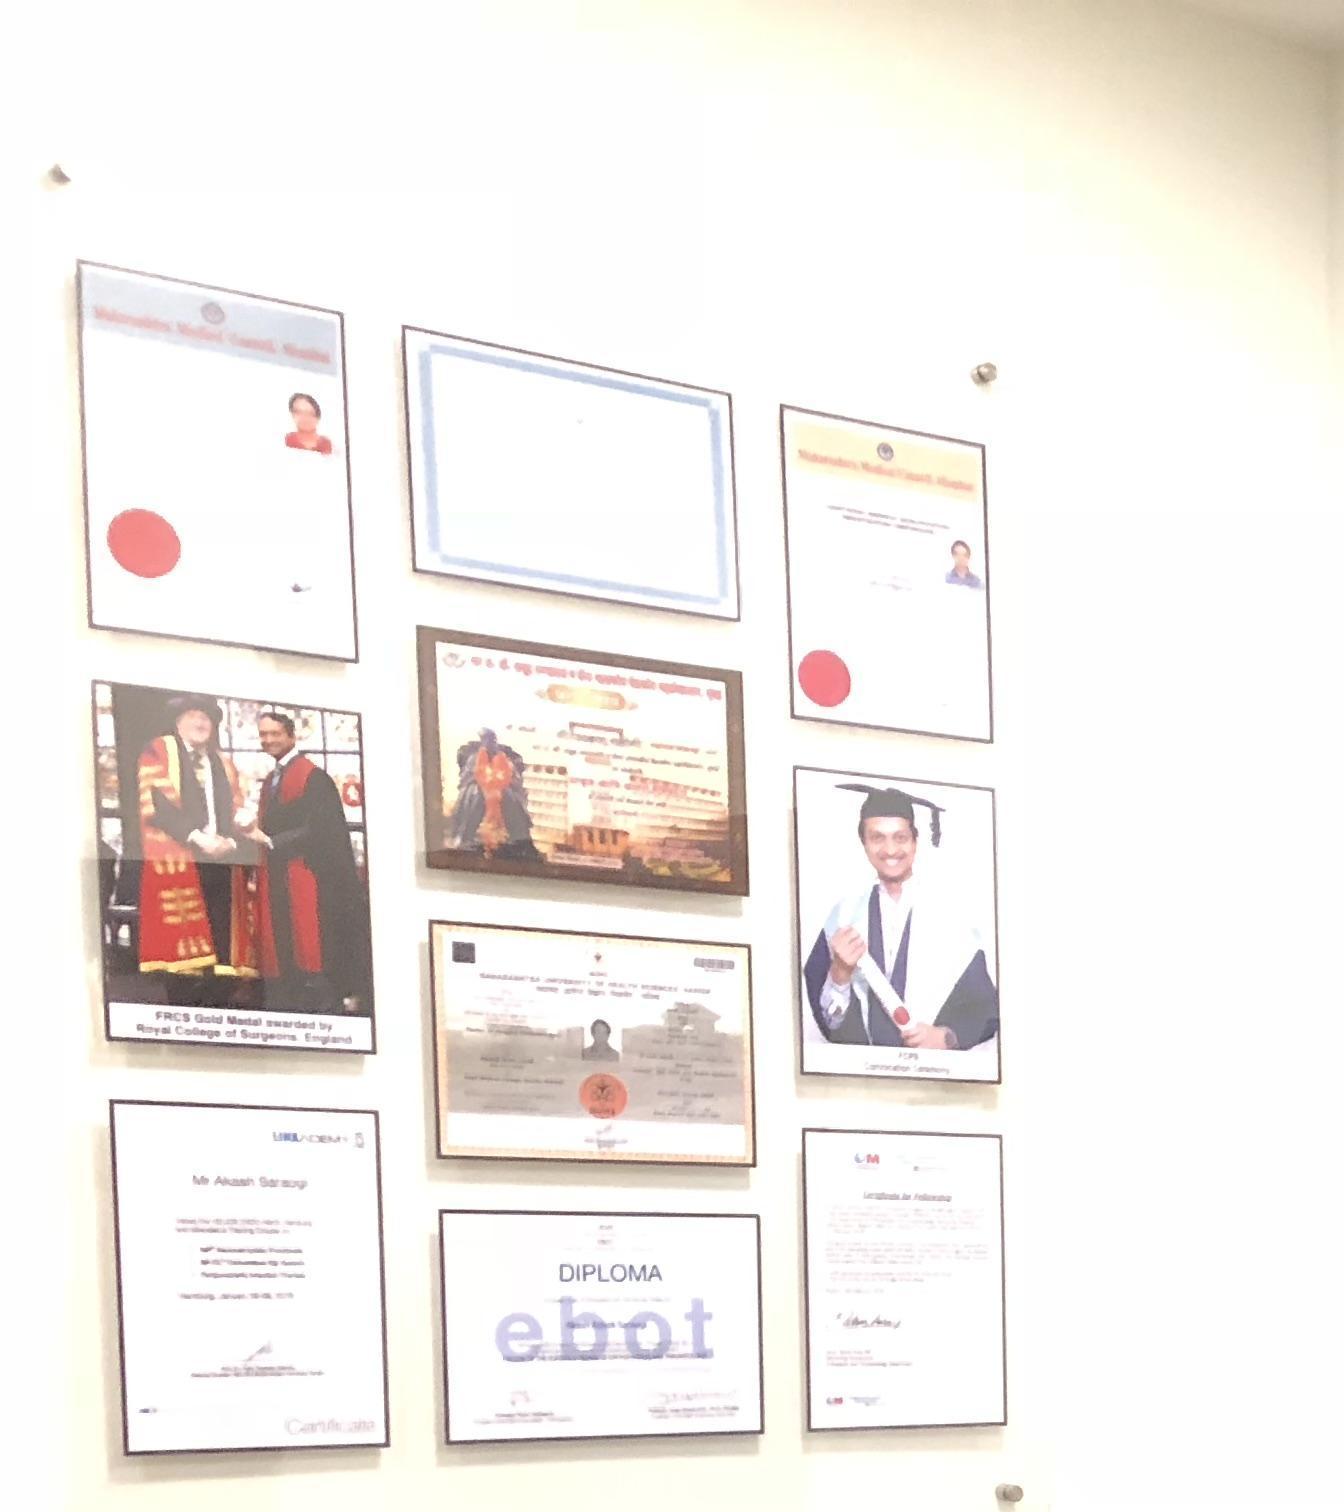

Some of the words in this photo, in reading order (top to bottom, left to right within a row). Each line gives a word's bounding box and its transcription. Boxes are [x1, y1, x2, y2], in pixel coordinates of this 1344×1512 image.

[155, 1010, 191, 1023] FRCS
[194, 1012, 223, 1025] Gold
[227, 1015, 262, 1027] Medal
[266, 1018, 315, 1030] awarded
[319, 1020, 333, 1033] by
[136, 1023, 171, 1037] Royal
[174, 1025, 221, 1039] College
[225, 1026, 237, 1038] of
[304, 1032, 353, 1045] England
[558, 1262, 663, 1283] DIPLOMA
[494, 1296, 714, 1363] ebot
